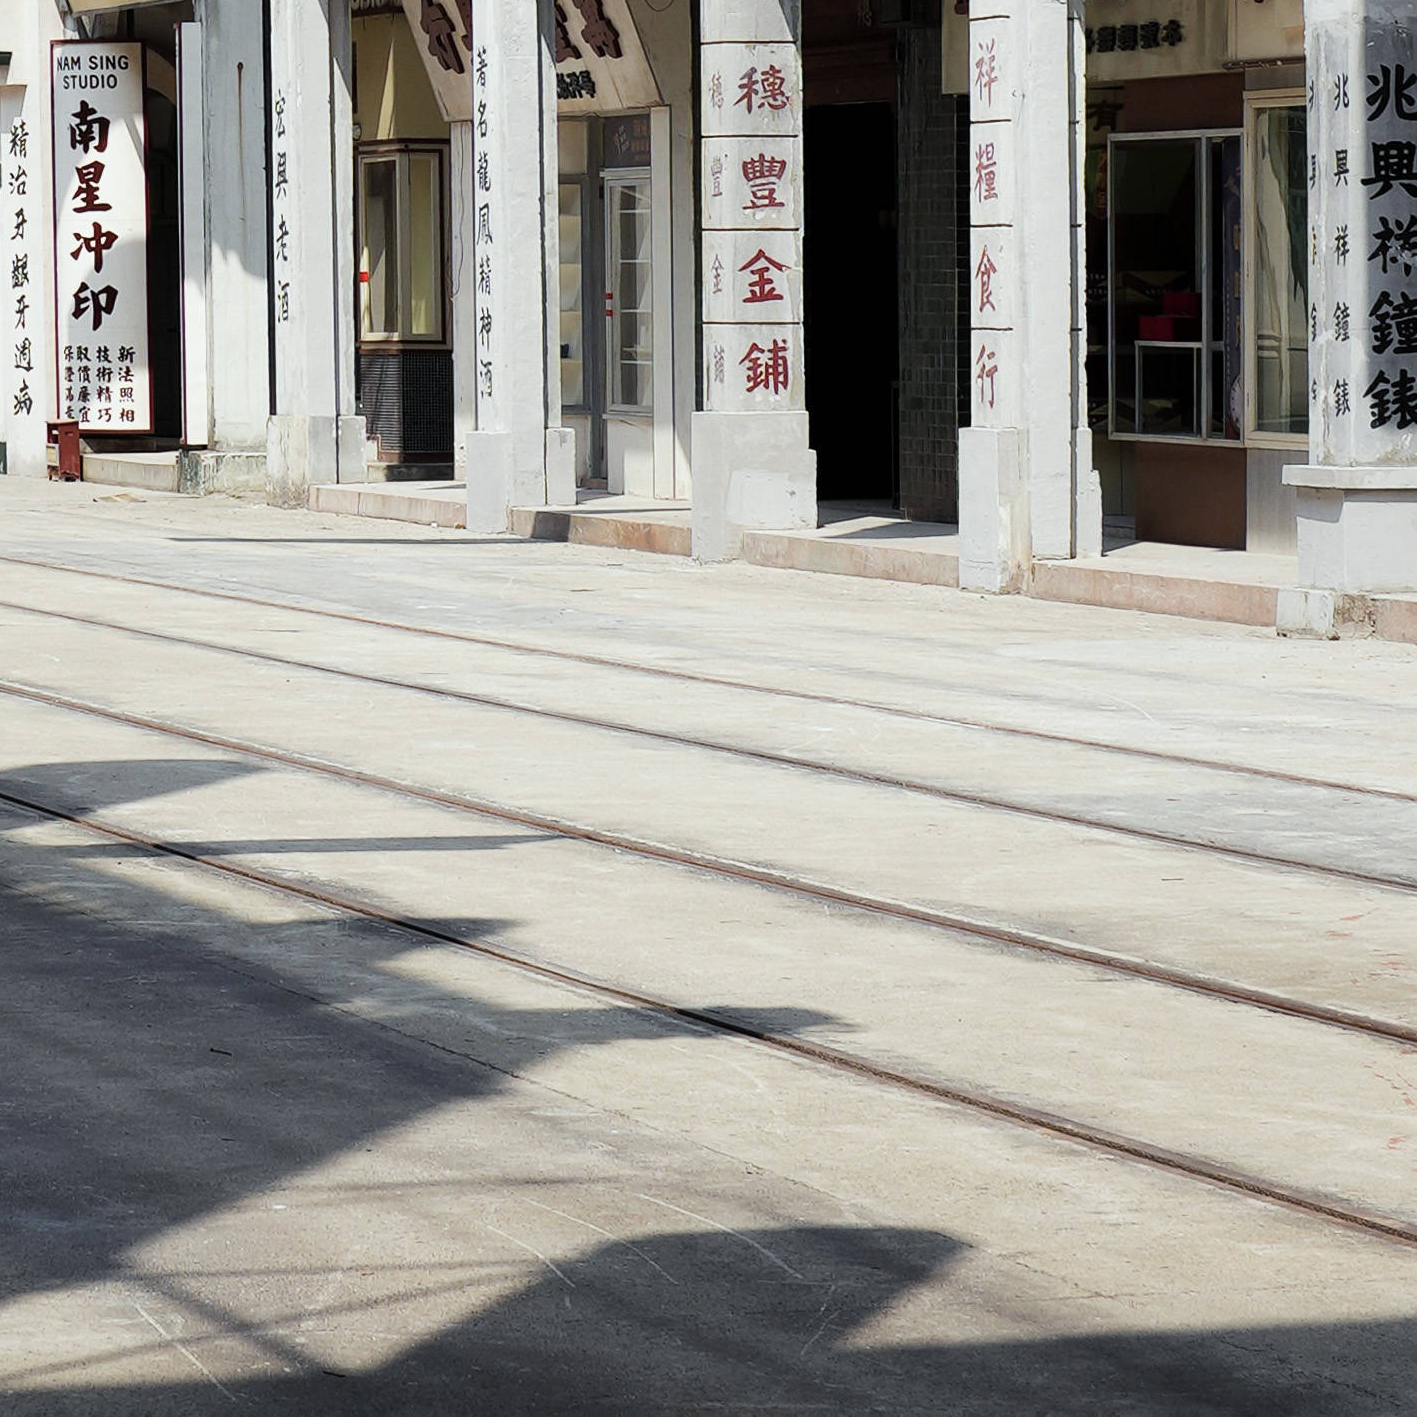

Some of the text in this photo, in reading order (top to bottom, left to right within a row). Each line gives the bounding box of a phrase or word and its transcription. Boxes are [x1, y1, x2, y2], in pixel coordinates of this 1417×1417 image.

[57, 54, 130, 71] NAM SING
[63, 73, 118, 89] STUDIO
[69, 100, 119, 331] 南星冲印
[95, 345, 113, 422] 技術精巧
[117, 345, 136, 422] 新法照相
